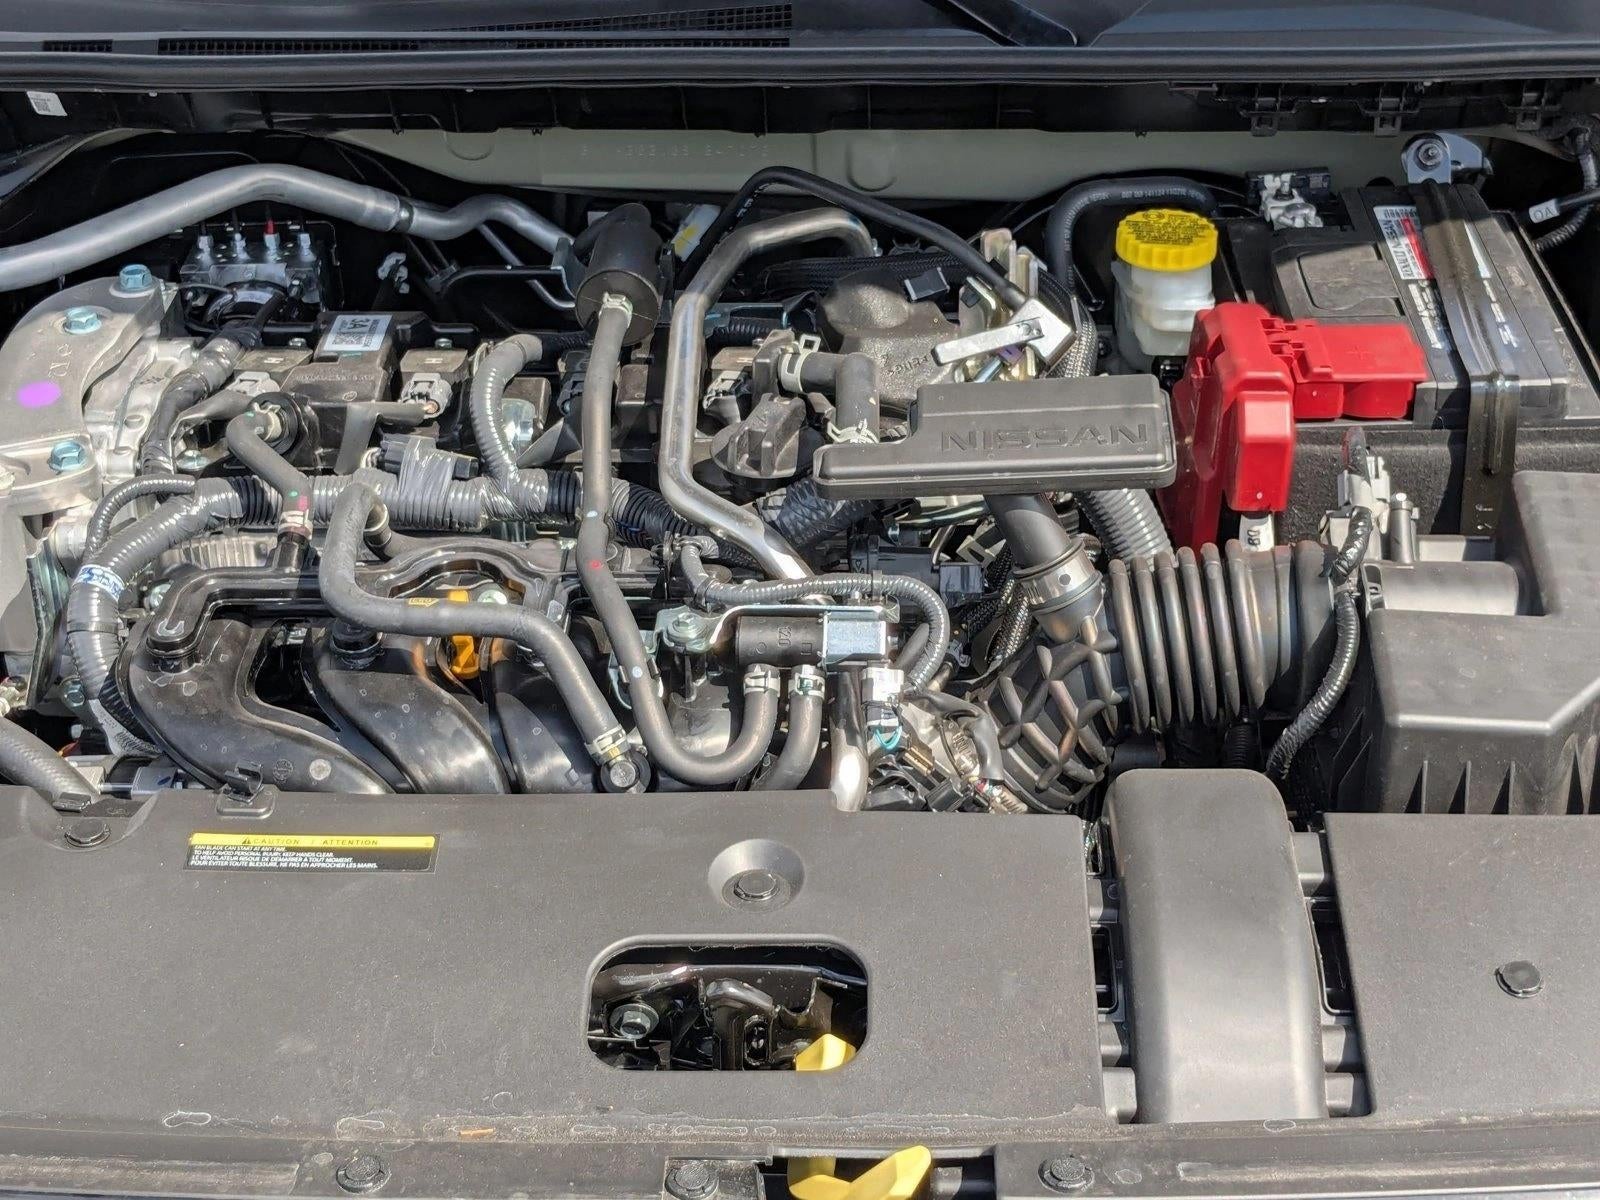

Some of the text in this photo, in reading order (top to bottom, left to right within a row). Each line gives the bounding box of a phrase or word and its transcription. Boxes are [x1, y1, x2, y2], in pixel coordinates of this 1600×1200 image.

[941, 423, 1148, 451] NISSAN
[253, 838, 300, 846] CAUTION
[322, 839, 379, 847] ATTENTION
